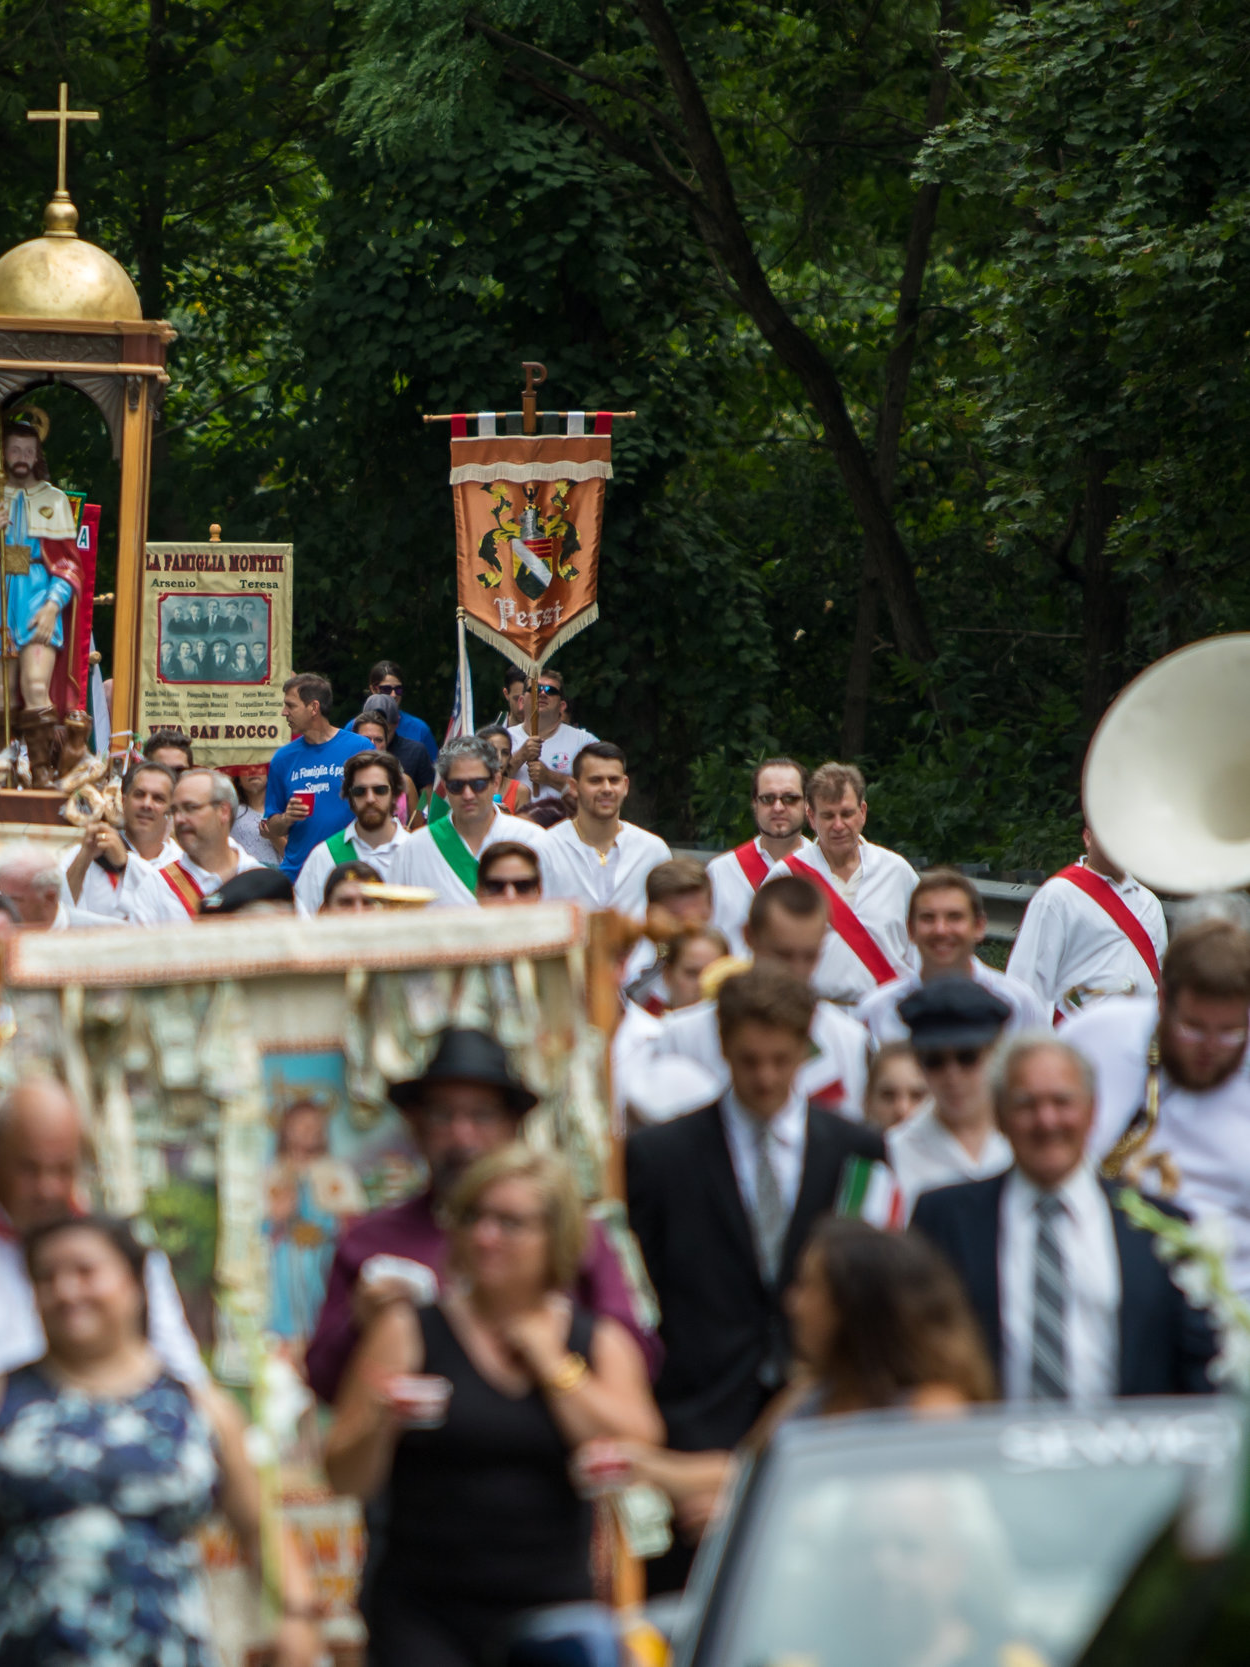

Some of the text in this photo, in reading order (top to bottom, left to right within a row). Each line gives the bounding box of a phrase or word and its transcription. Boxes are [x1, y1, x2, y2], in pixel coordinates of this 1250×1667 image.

[145, 553, 284, 572] LA FAMIGLIA MONTINI
[151, 578, 196, 588] Arsenio
[239, 579, 279, 589] Teresa
[190, 724, 220, 739] SAN
[224, 724, 279, 739] ROCCO
[291, 770, 300, 782] La
[300, 764, 328, 779] Famiglia
